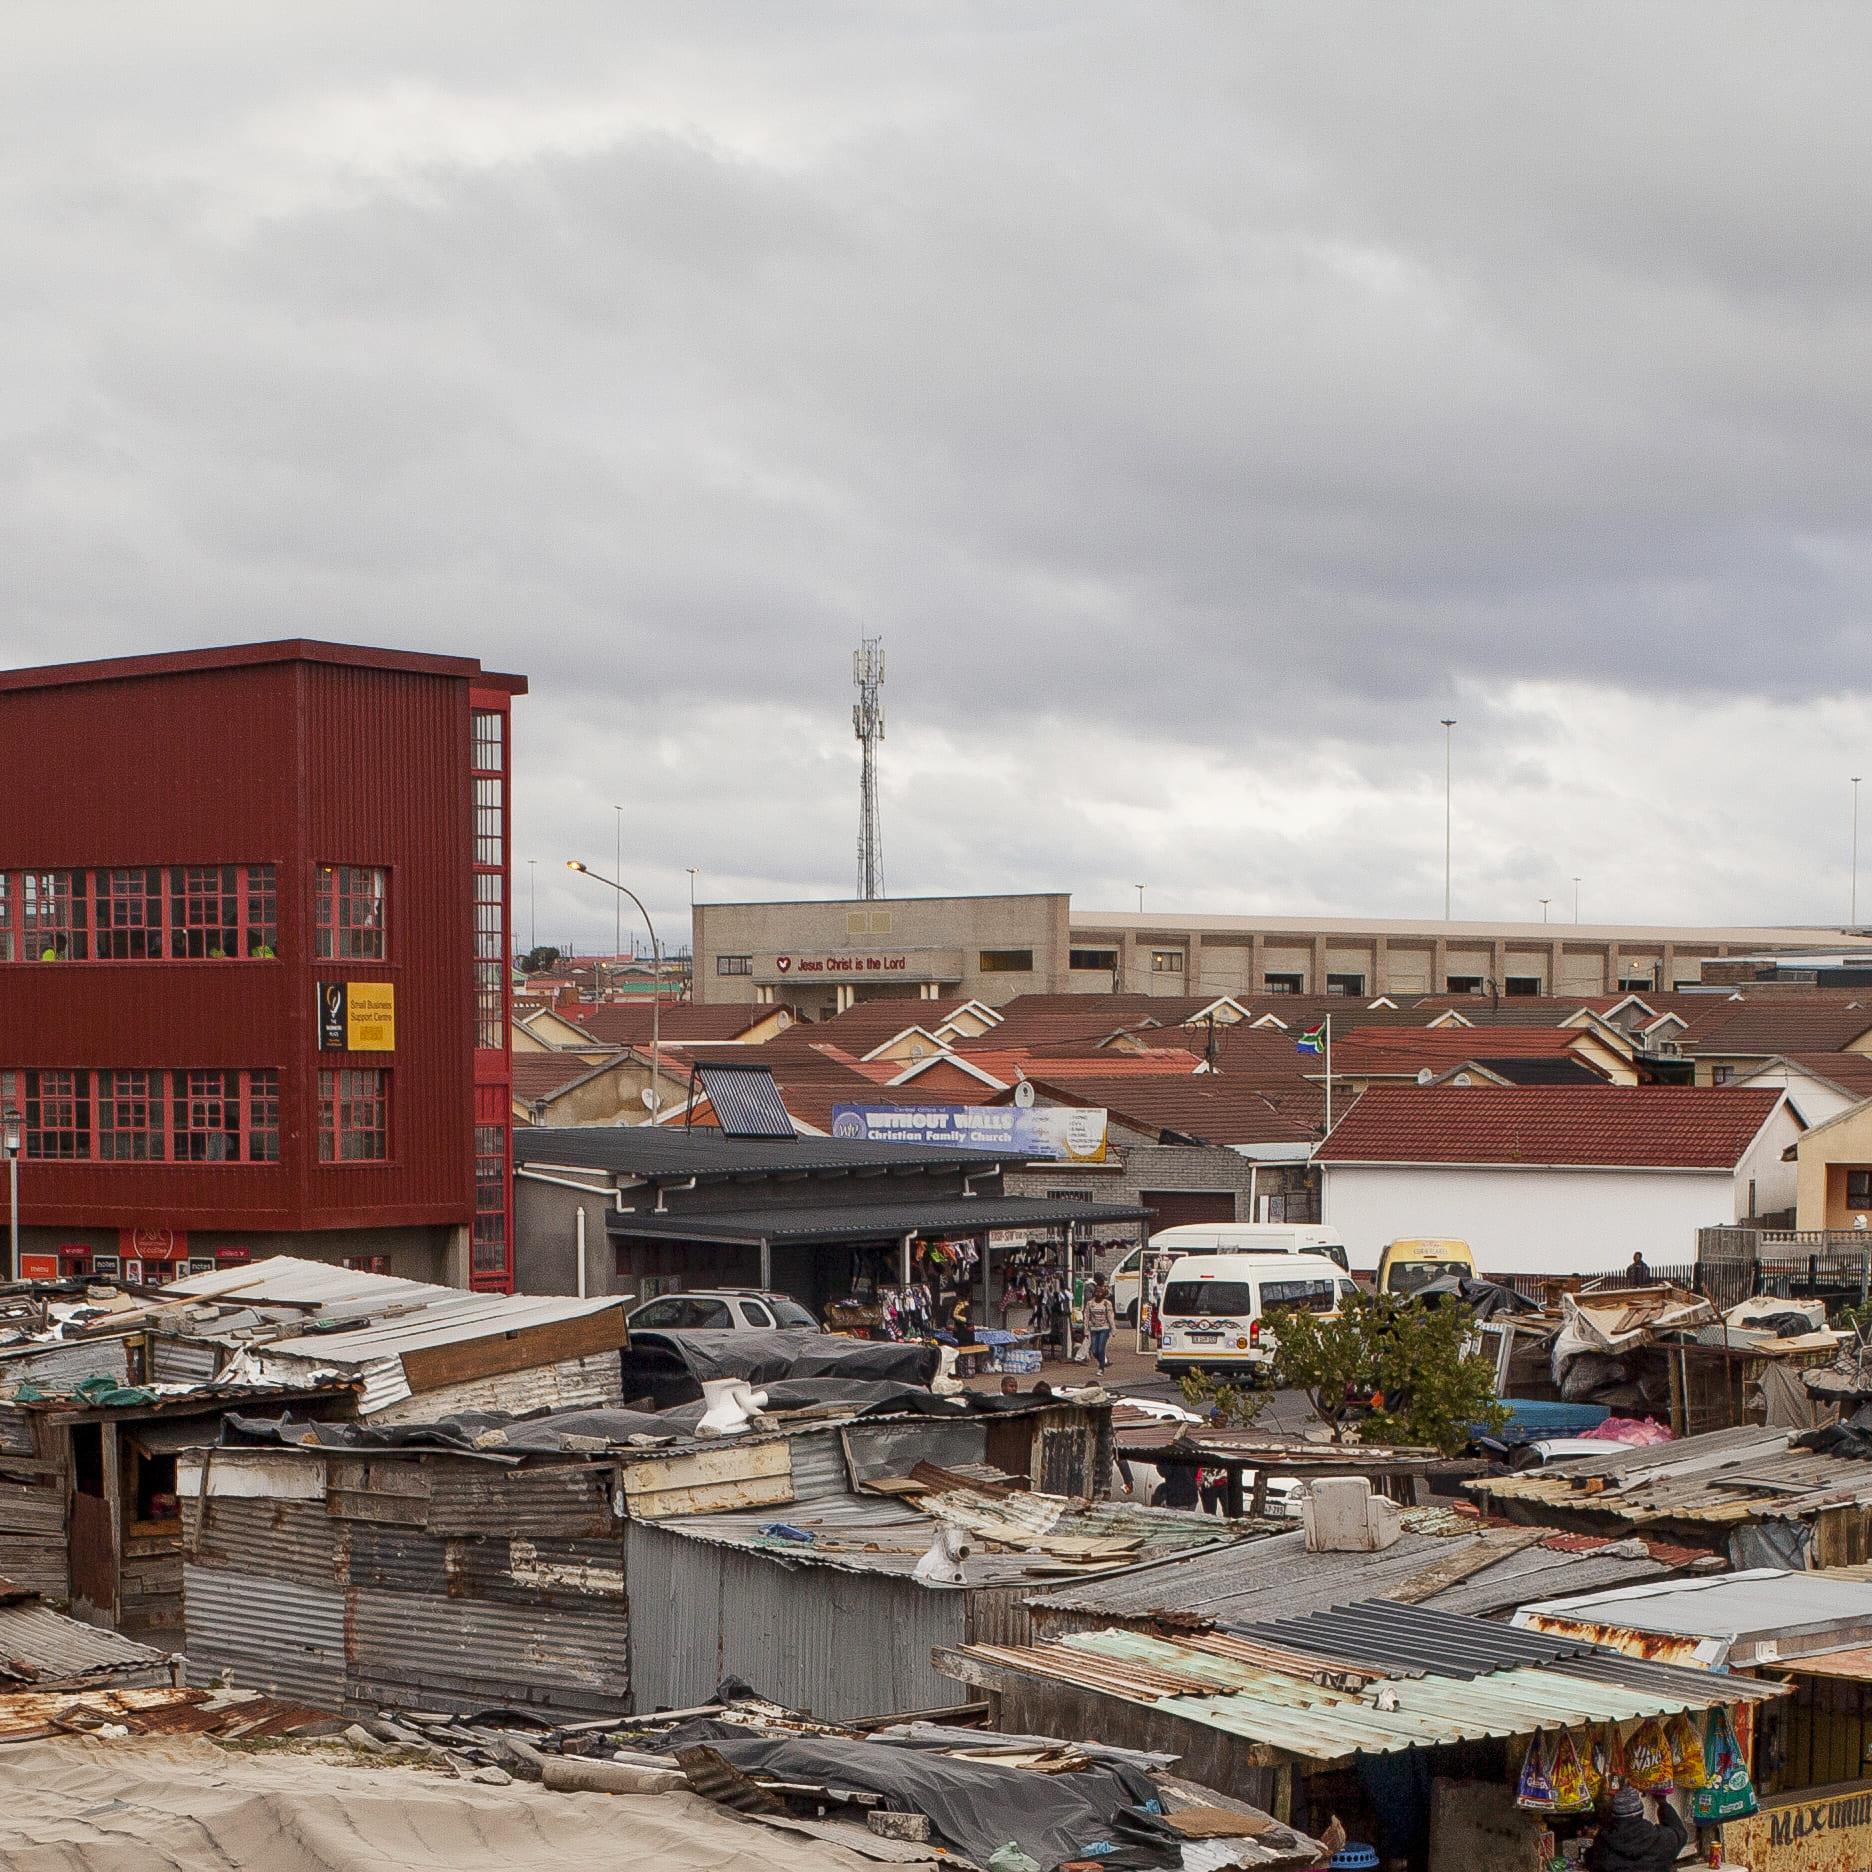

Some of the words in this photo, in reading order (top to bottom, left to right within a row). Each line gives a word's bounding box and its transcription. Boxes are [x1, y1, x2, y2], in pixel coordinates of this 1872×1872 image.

[798, 958, 823, 971] Jesus
[826, 957, 853, 970] Christ
[855, 958, 864, 970] is
[866, 957, 881, 969] the
[883, 956, 906, 969] Lord
[350, 1000, 366, 1009] Small
[367, 1000, 392, 1009] Business
[865, 1112, 949, 1128] WITHOUT
[953, 1113, 1016, 1129] WALLS
[867, 1130, 922, 1140] Christian
[926, 1131, 966, 1143] Family
[970, 1131, 1012, 1142] Church
